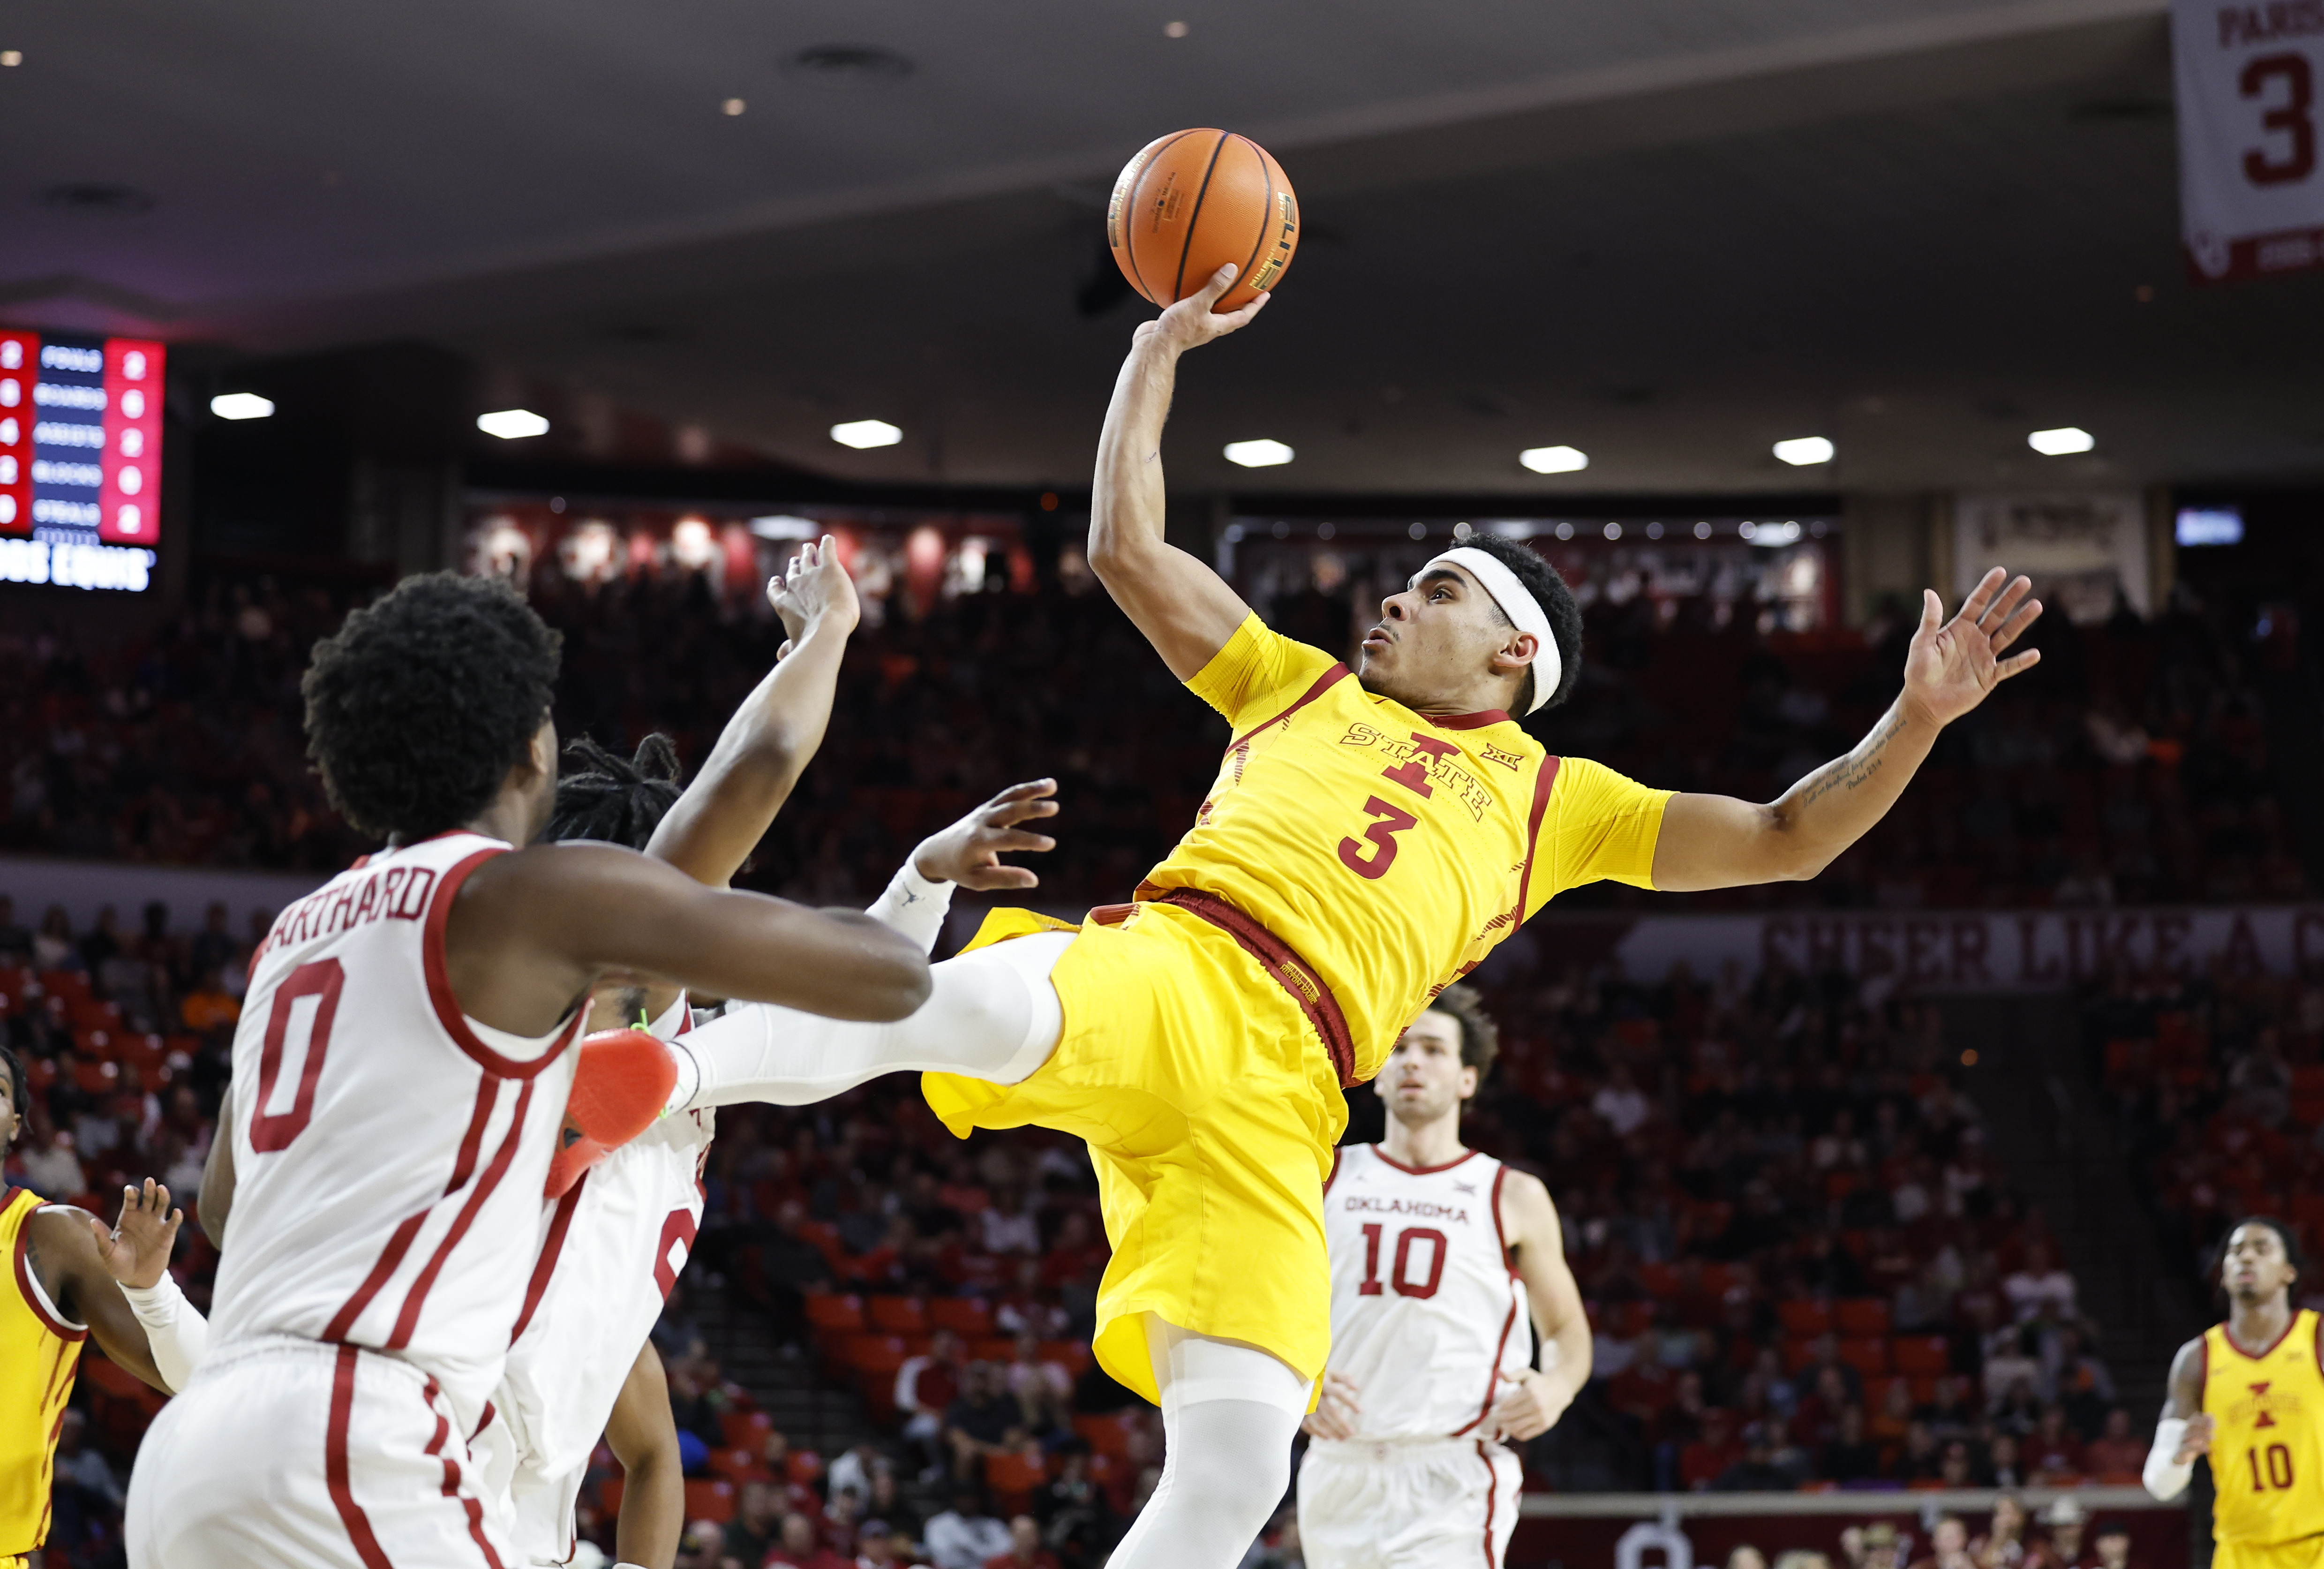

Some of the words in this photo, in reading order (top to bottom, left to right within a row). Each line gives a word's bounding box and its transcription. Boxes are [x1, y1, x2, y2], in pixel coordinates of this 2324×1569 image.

[2240, 53, 2314, 187] 3
[1339, 723, 1492, 823] STATE
[1479, 742, 1525, 772] XII
[1337, 795, 1418, 880] 3
[1279, 964, 1302, 986] HILTON
[1299, 985, 1316, 1005] MAGIC
[249, 957, 346, 1154] 0
[1346, 1196, 1469, 1226] OKLAHOMA
[1359, 1223, 1447, 1300] 10
[2247, 1444, 2294, 1492] 10
